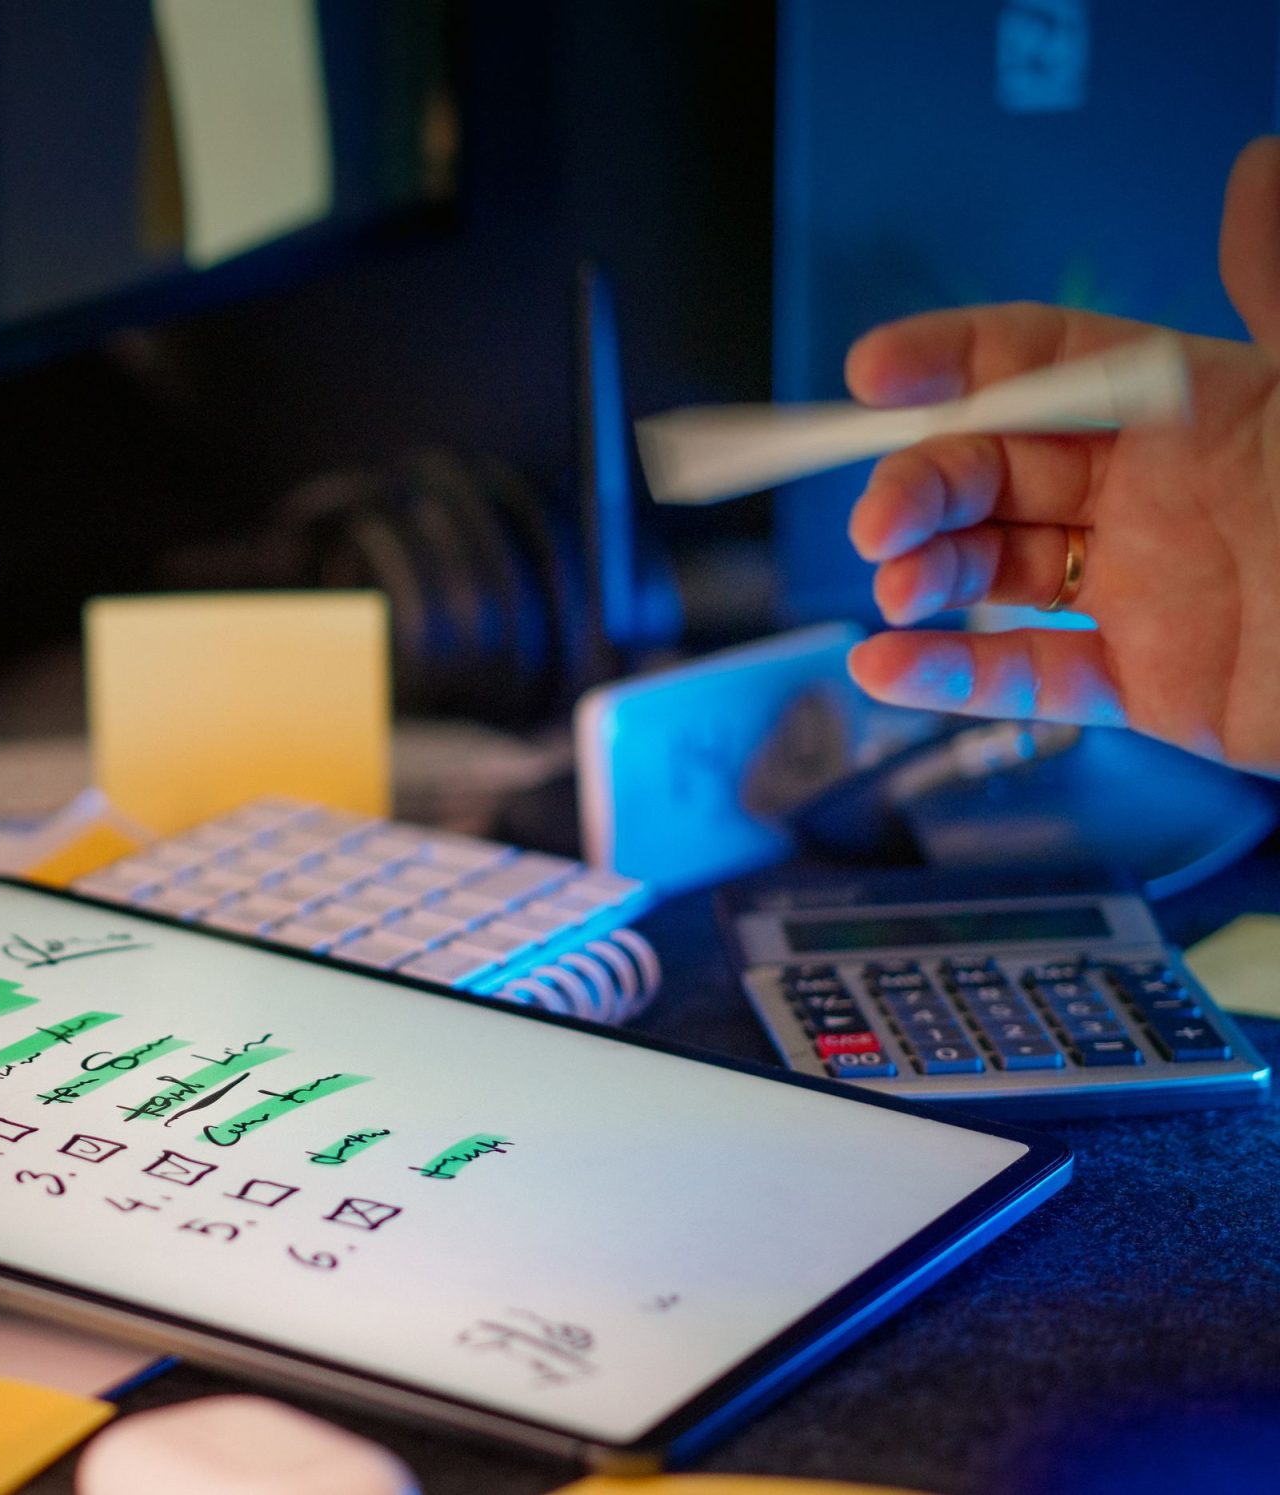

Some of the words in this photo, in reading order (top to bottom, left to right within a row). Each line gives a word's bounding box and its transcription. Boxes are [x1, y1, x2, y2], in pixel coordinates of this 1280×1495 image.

[839, 1051, 881, 1066] 00
[934, 1046, 959, 1061] 0
[15, 1169, 77, 1196] 3.
[177, 1217, 258, 1242] 5.
[287, 1244, 357, 1270] 6.
